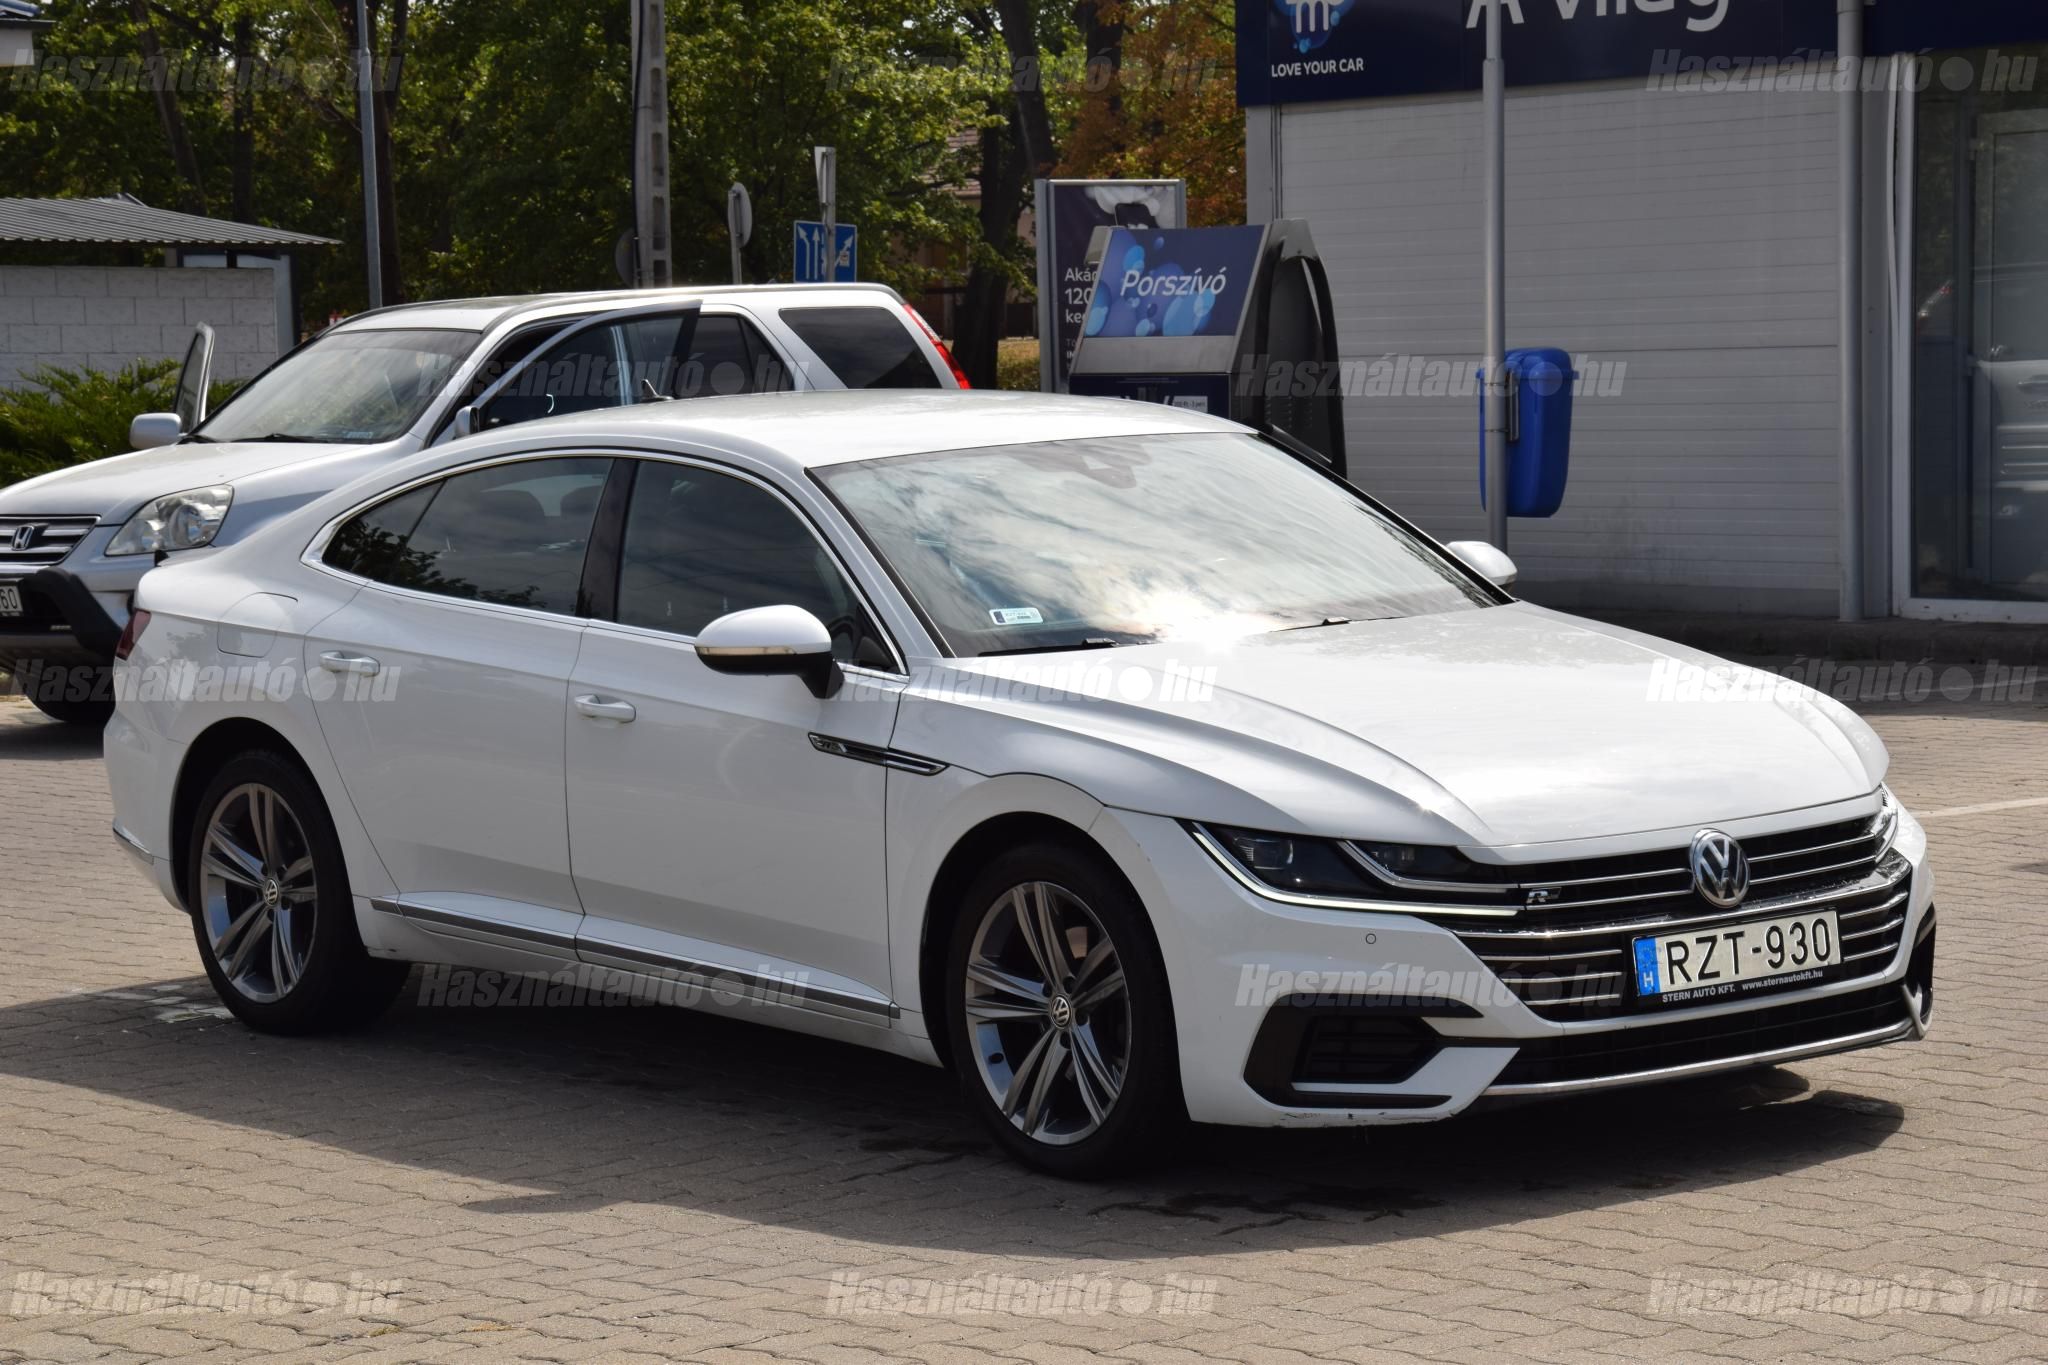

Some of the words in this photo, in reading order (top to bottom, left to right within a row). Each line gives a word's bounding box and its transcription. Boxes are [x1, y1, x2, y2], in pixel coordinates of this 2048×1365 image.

[1271, 62, 1302, 78] LOVE
[1303, 59, 1337, 75] YOUR
[1339, 57, 1364, 73] CAR
[1120, 266, 1227, 297] Porszívó
[1665, 917, 1831, 985] RZT-930
[1643, 972, 1654, 988] H
[1662, 990, 1692, 1004] STERN
[1692, 985, 1716, 1000] AUTÓ
[1718, 983, 1736, 995] KFT.
[1741, 969, 1824, 991] www.sternautokft.hu
